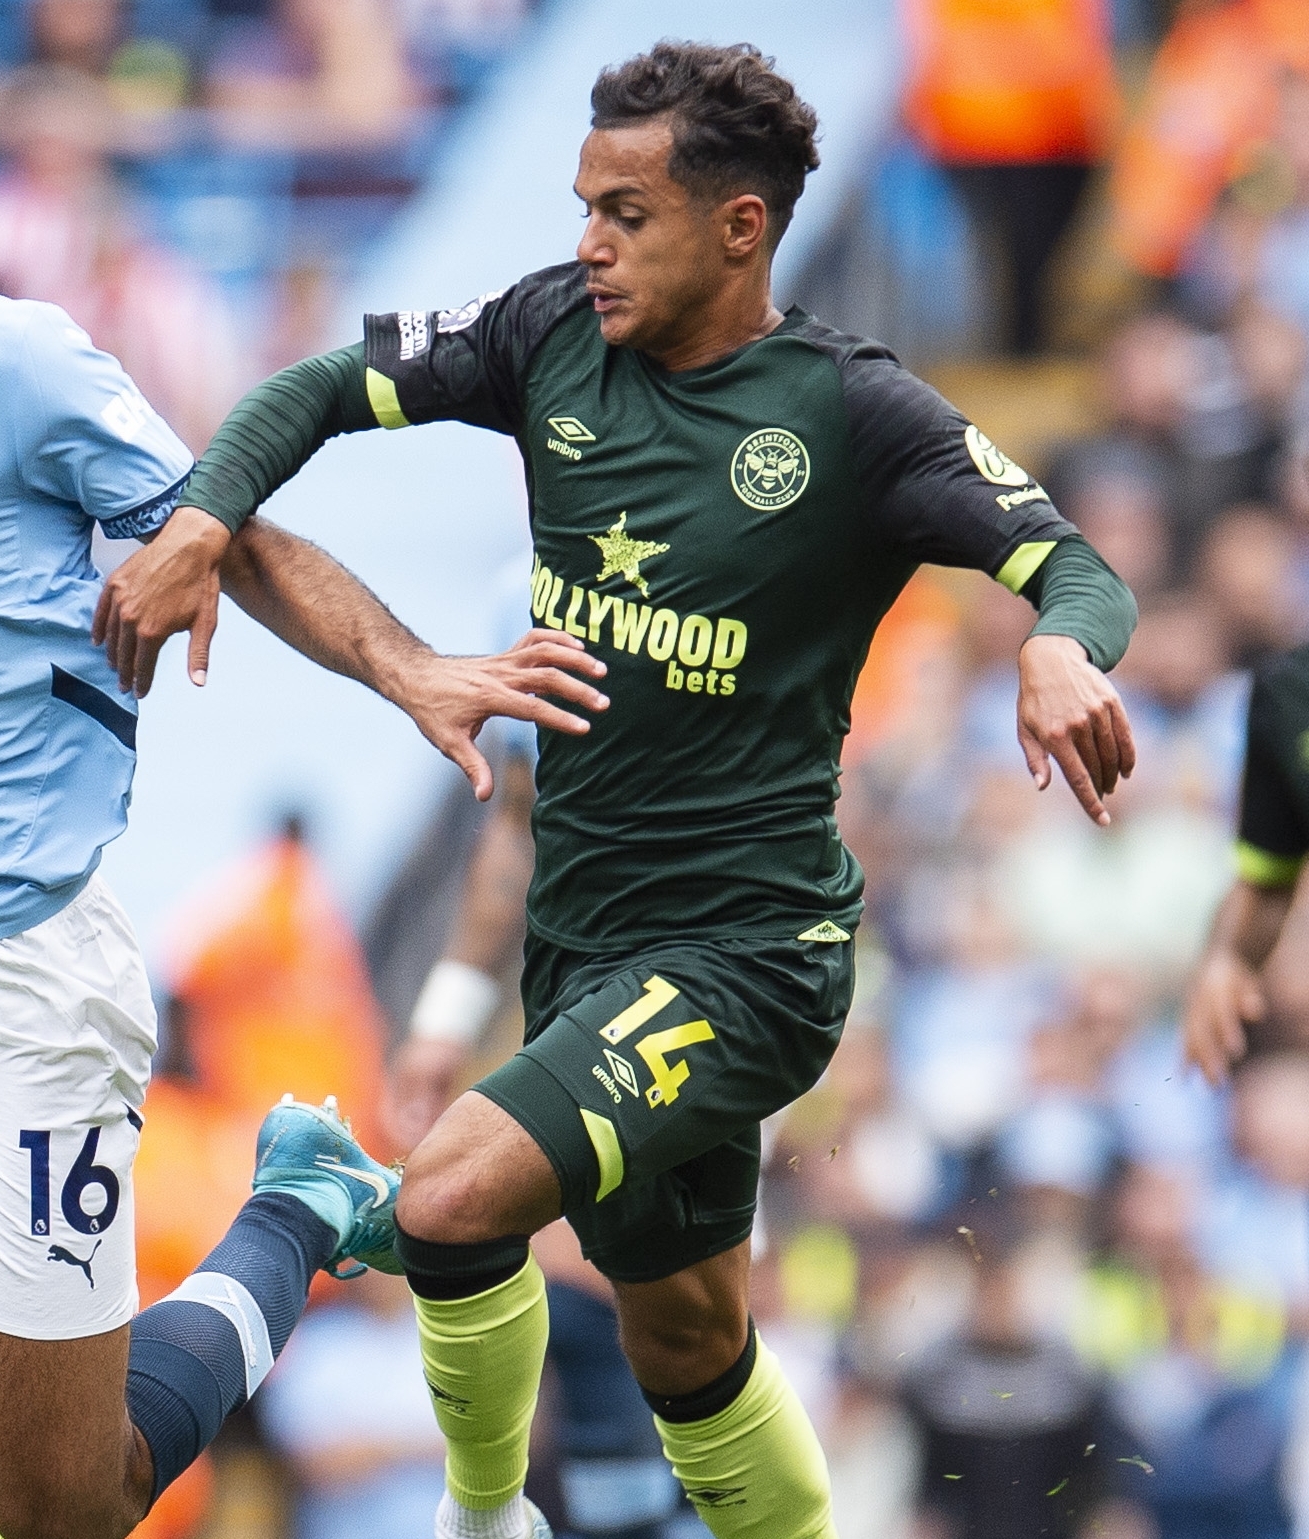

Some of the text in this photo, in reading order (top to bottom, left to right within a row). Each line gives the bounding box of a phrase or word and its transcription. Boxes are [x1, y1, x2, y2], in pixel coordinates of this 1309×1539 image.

[547, 437, 582, 460] umbro
[745, 433, 801, 457] BRENTFORD
[739, 483, 795, 505] FOOTBALL CLUB
[665, 660, 737, 696] bets
[598, 974, 716, 1109] 14
[592, 1064, 622, 1104] umbro
[18, 1125, 120, 1236] 16
